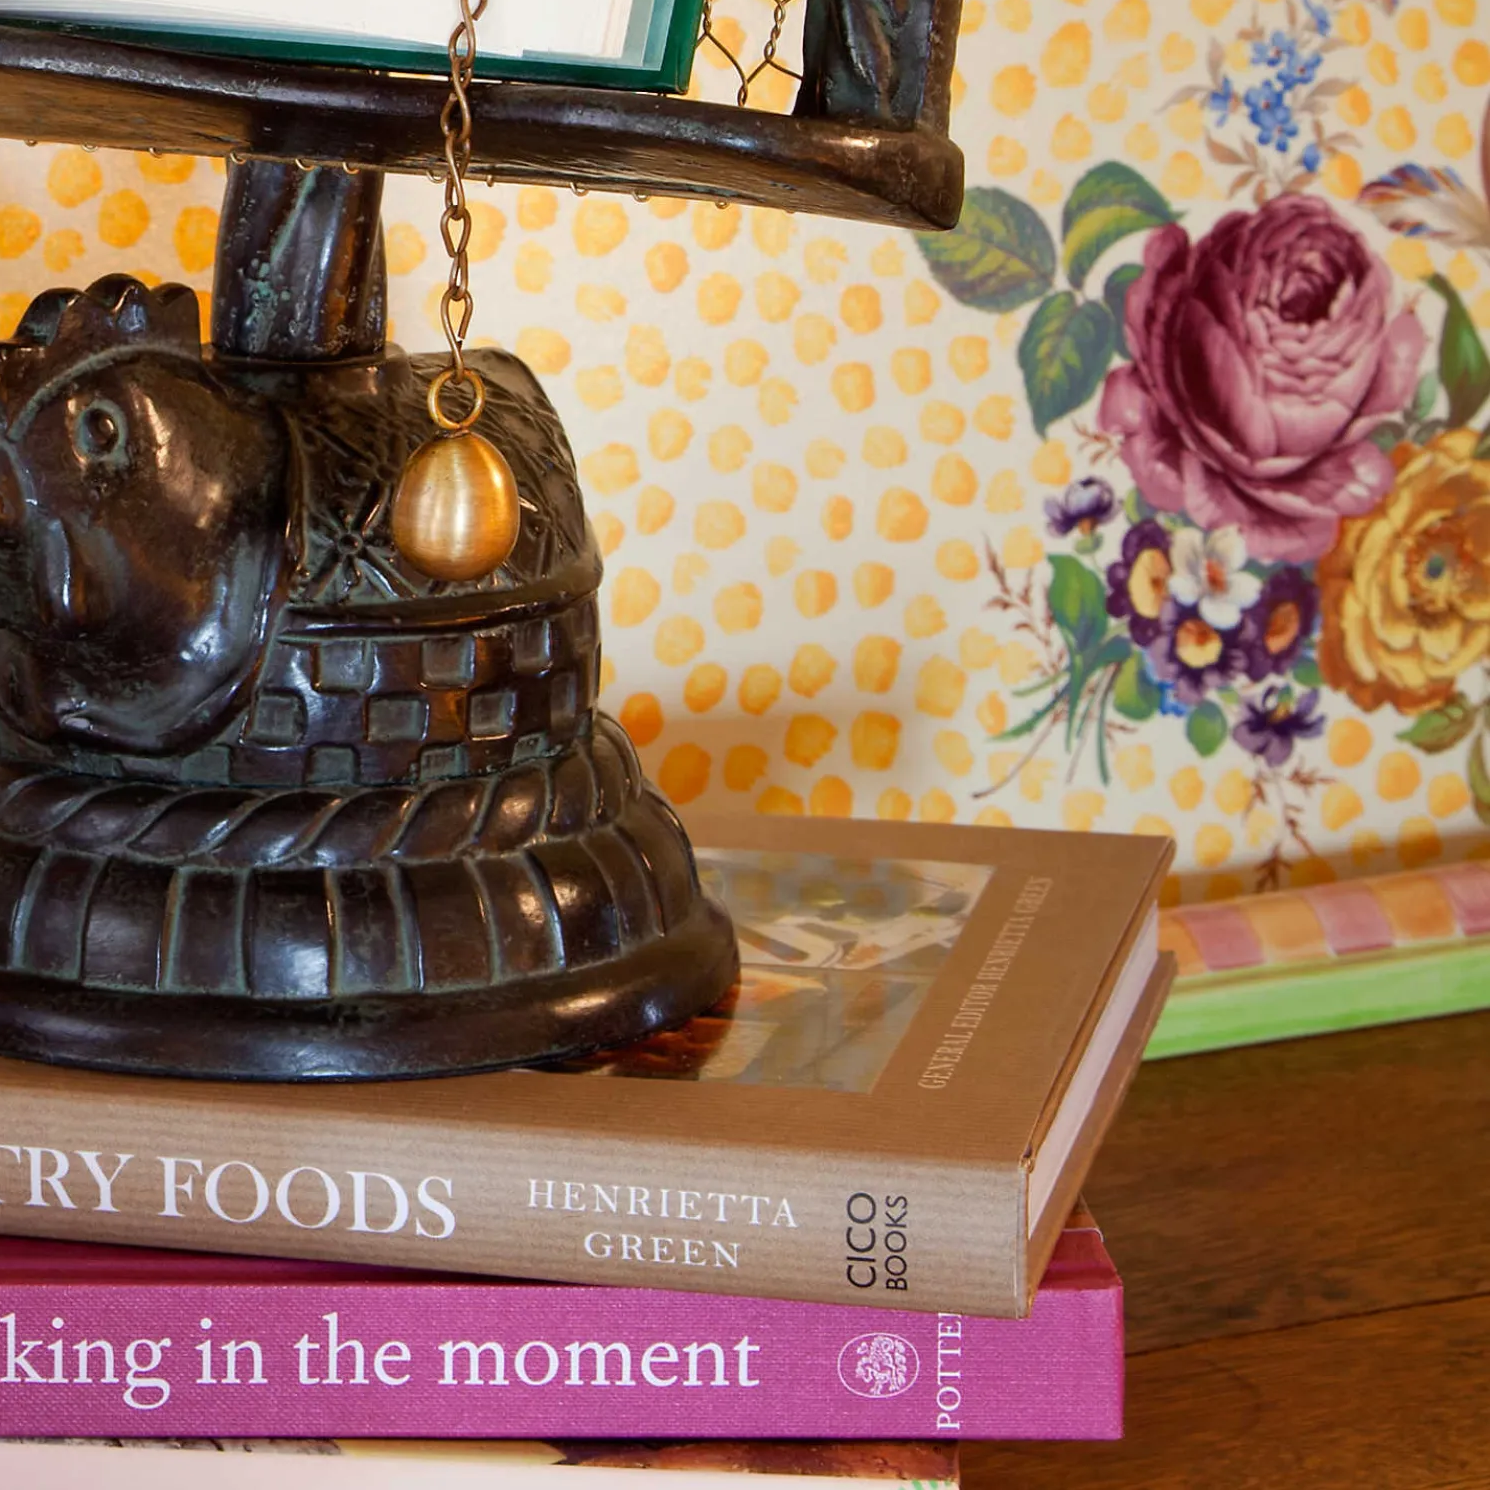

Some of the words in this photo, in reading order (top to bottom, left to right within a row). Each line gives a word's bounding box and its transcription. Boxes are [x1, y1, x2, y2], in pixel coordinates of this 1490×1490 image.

[917, 1028, 974, 1090] GENERAL
[950, 983, 1000, 1030] EDITOR
[976, 915, 1036, 981] HENRIETTA
[155, 1155, 457, 1240] FOODS
[527, 1177, 799, 1229] HENRIETTA
[845, 1191, 877, 1289] CICO
[884, 1194, 908, 1291] BOOKS
[583, 1231, 742, 1269] GREEN
[194, 1316, 268, 1386] in
[293, 1310, 412, 1387] the
[437, 1334, 761, 1388] moment
[935, 1311, 962, 1431] POTTE
